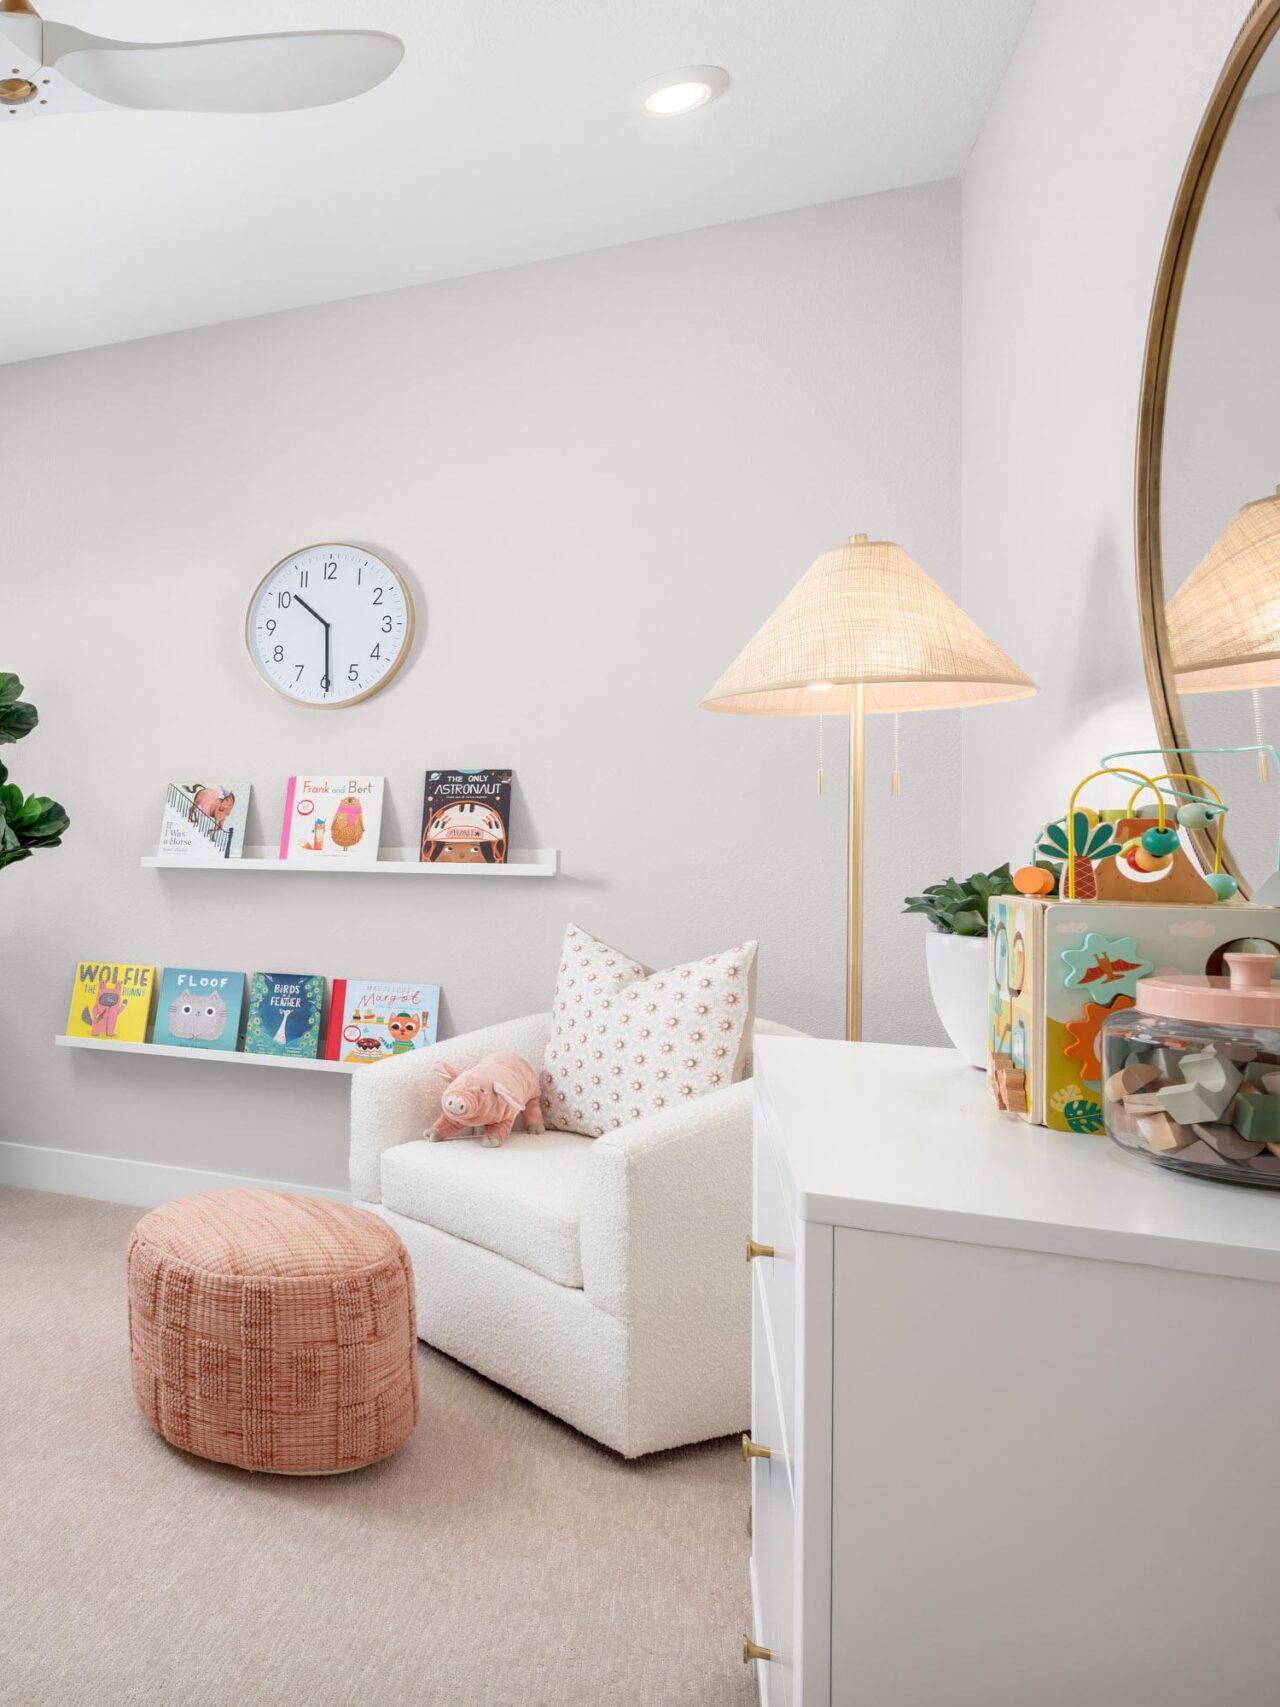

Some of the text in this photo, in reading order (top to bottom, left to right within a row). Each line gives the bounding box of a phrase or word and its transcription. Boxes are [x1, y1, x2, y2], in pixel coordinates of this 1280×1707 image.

[300, 570, 309, 589] 11
[323, 562, 338, 580] 12
[357, 567, 362, 586] 1
[277, 591, 291, 609] 10
[372, 587, 384, 606] 2
[265, 619, 277, 636] 9
[381, 615, 393, 633] 3
[273, 644, 284, 663] 8
[369, 642, 381, 661] 4
[294, 664, 305, 682] 7
[347, 663, 359, 682] 5
[302, 780, 374, 794] Frank and Bert
[446, 774, 489, 783] THE ONLY
[434, 783, 502, 795] ASTRONAUT
[169, 837, 192, 846] Horse
[80, 964, 150, 987] WOLFIE
[177, 974, 229, 988] FLOOF
[270, 996, 301, 1008] FEATHER
[357, 990, 422, 1009] Margot
